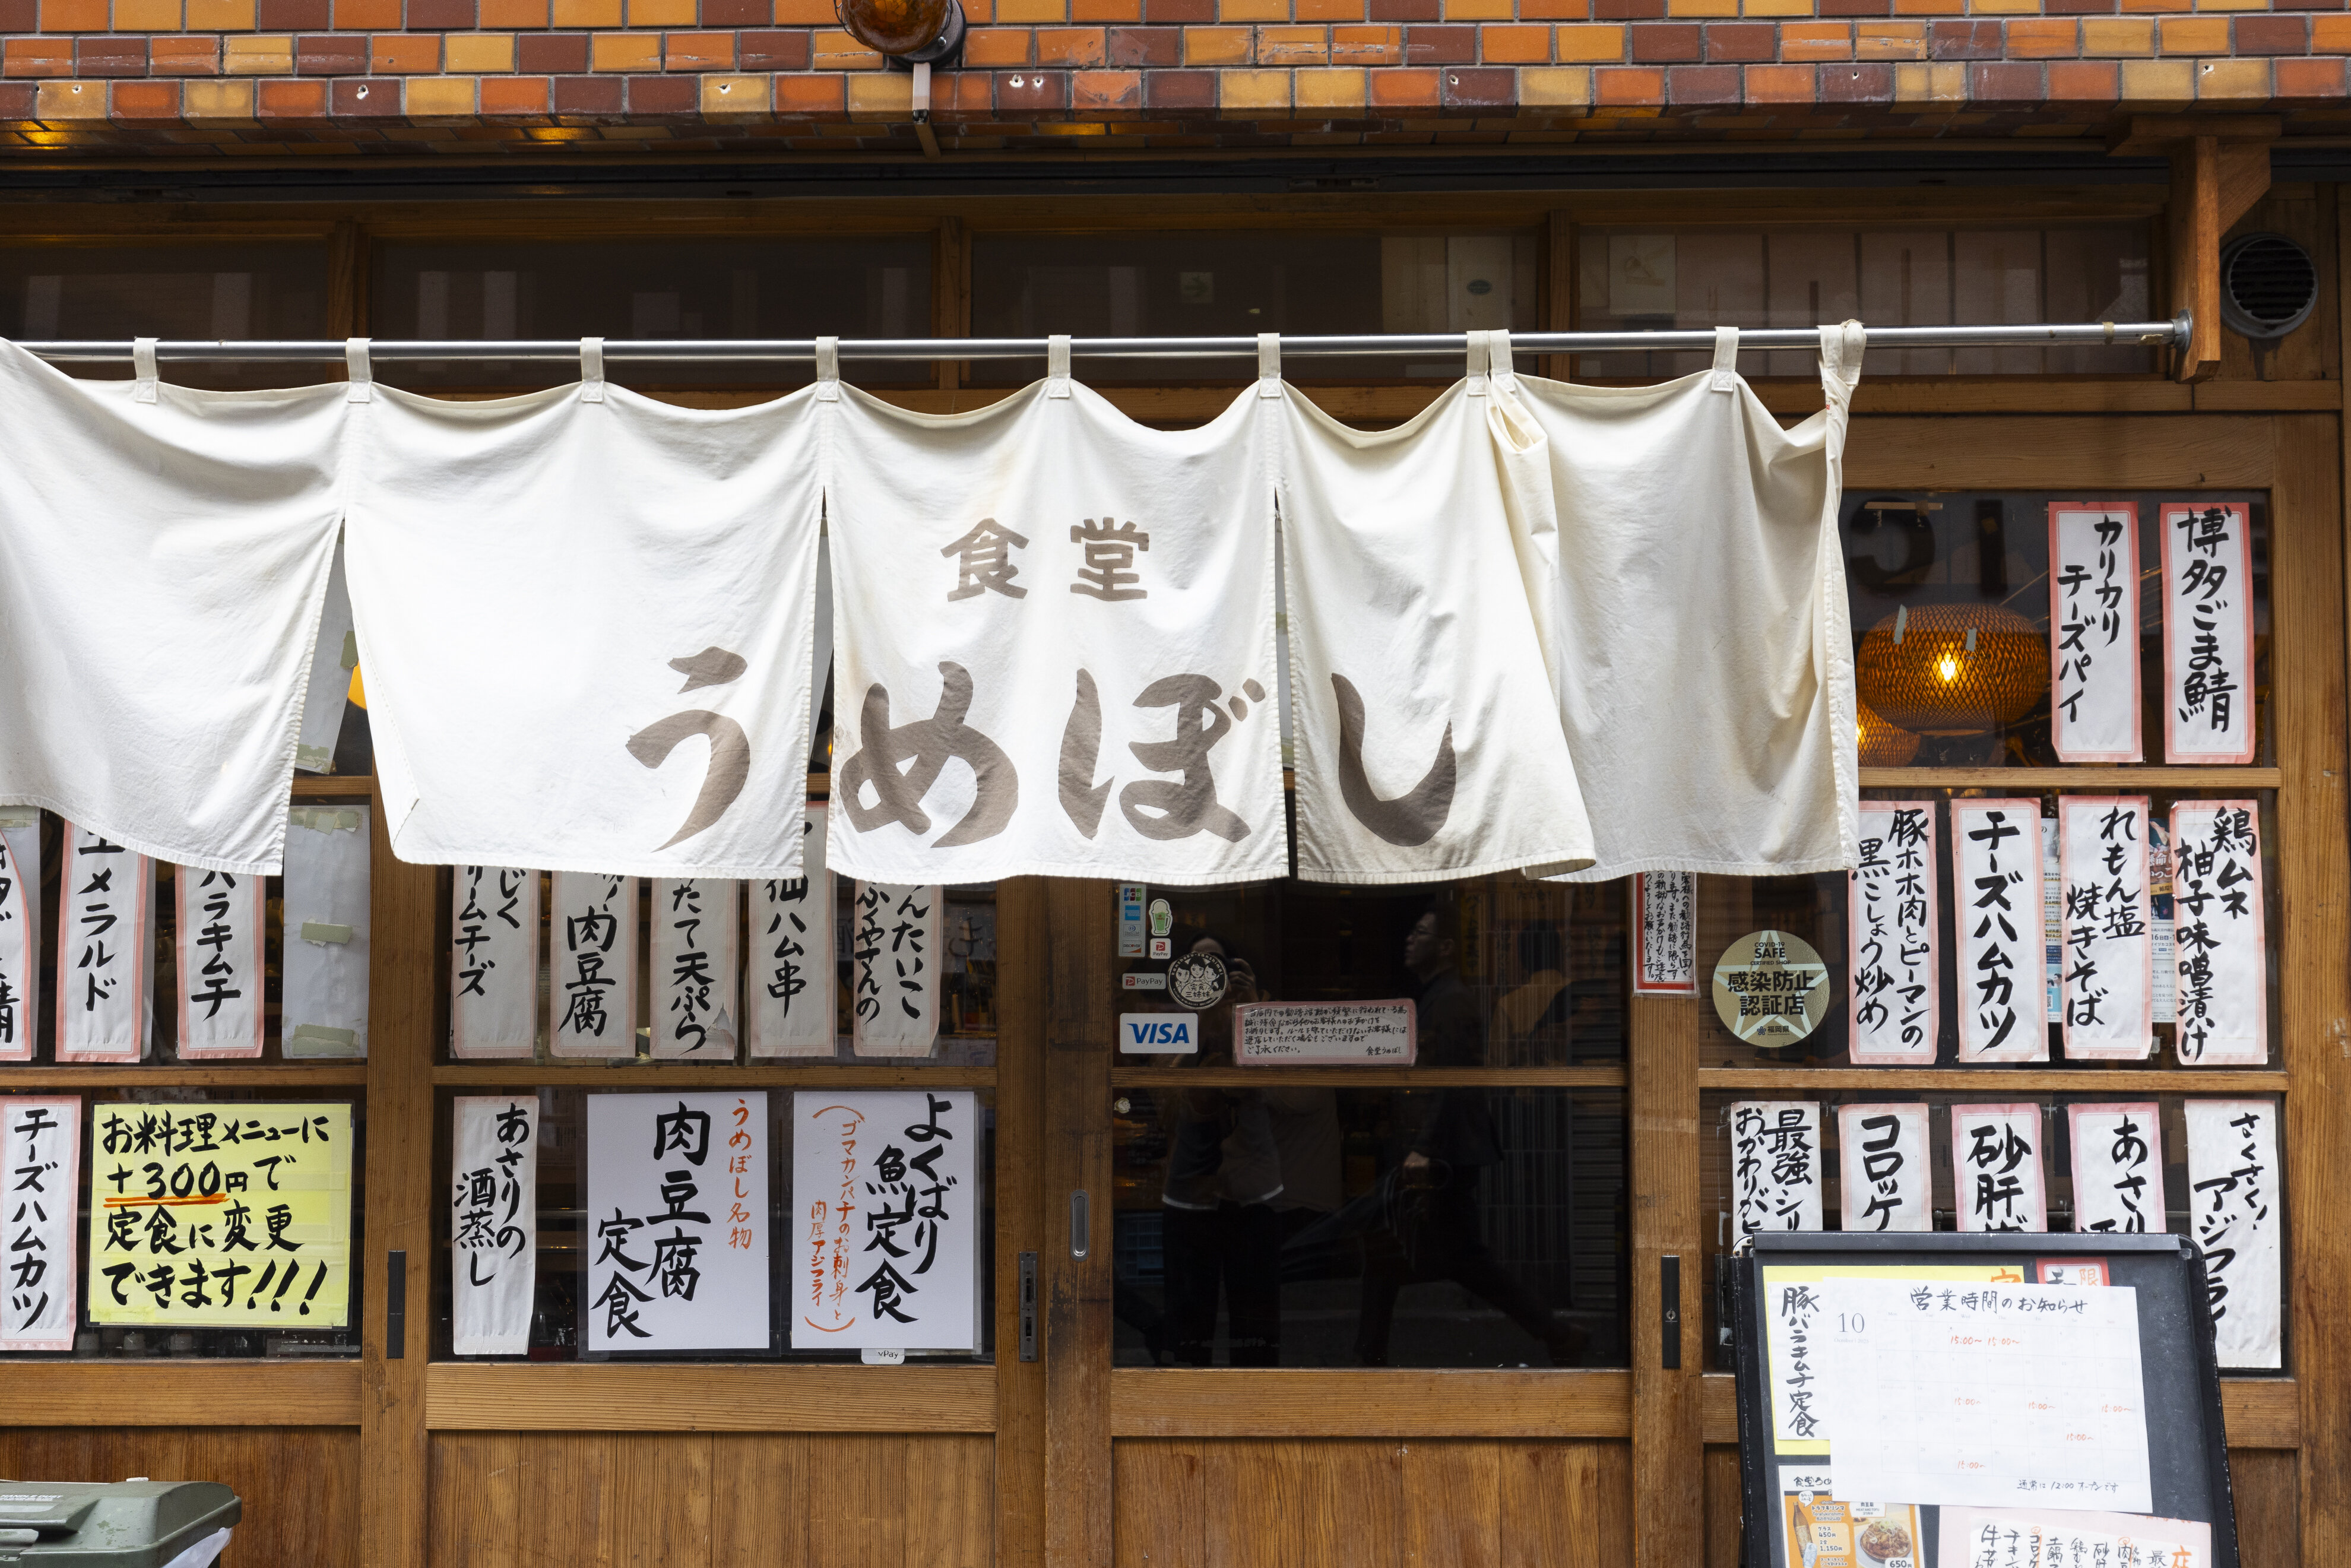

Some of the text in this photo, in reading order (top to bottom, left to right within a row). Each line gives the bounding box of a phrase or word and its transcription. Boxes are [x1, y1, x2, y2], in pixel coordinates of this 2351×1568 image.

[941, 517, 1149, 601] 食堂
[2095, 514, 2123, 648] カリカリ
[2177, 506, 2238, 733] 博多ごま鯖
[2058, 565, 2096, 722] チーズパイ
[626, 646, 1456, 853] うめぼし
[497, 869, 526, 930] じく
[1889, 808, 1931, 1049] 豚ホホ肉とピーマンの
[2100, 806, 2146, 939] れもん塩
[2211, 806, 2256, 918] 鶏ムネ
[671, 879, 717, 1056] たて天ぷら
[892, 885, 931, 1019] んたいこ
[1728, 971, 1815, 993] 感染防止
[1754, 948, 1785, 958] SAFE
[1851, 838, 1894, 1034] 黒こしょう炒め
[1968, 811, 2023, 1055] チーズハムカツ
[2065, 882, 2109, 1027] 焼きそば
[2174, 839, 2221, 1062] 柚子味噌漬け
[1127, 1023, 1189, 1044] VISA
[1366, 1046, 1401, 1056] 食堂うめぼし
[1740, 995, 1804, 1016] 認証店
[102, 1110, 330, 1156] お料理メニューに
[495, 1103, 530, 1259] あさりの
[728, 1098, 752, 1250] うめぼし名物
[905, 1093, 957, 1274] よくばり
[1861, 1115, 1903, 1230] コロッケ
[10, 1110, 58, 1333] チーズハムカツ
[103, 1200, 305, 1254] 定食に変更
[454, 1167, 498, 1287] 酒蒸し
[646, 1101, 711, 1302] 肉豆腐
[854, 1145, 919, 1323] 魚定食
[591, 1208, 654, 1338] 定食
[1838, 1313, 1865, 1333] 10
[1910, 1285, 2088, 1314] 営業時間のお知らせ
[1781, 1286, 1820, 1437] 豚バラキムチ定食
